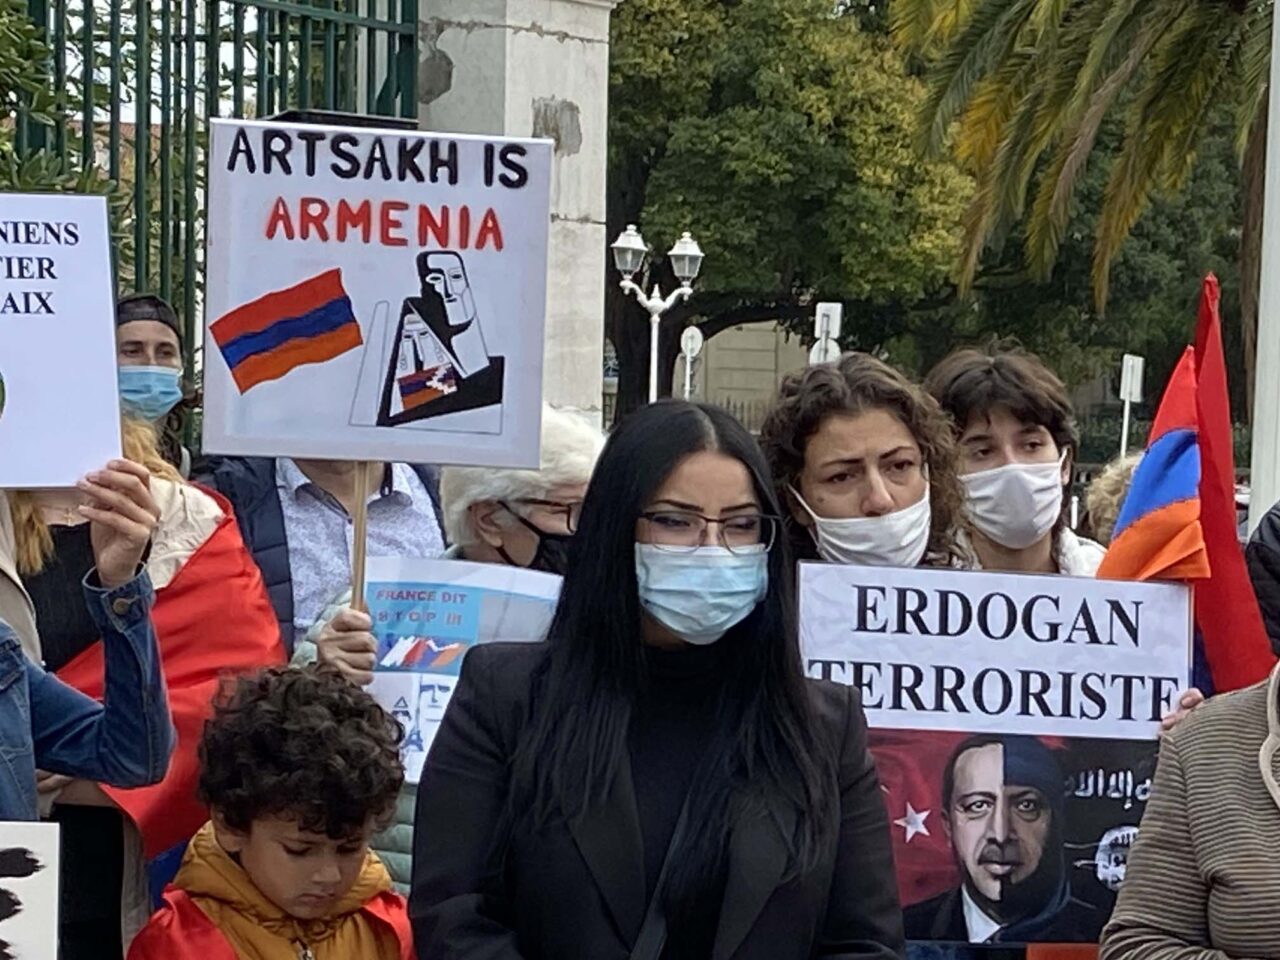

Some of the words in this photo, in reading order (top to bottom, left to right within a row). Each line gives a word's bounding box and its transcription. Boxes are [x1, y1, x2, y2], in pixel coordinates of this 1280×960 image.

[227, 127, 459, 187] ARTSAKH
[483, 142, 529, 189] IS
[265, 196, 504, 251] ARMENIA
[376, 589, 436, 602] FRANCE
[441, 591, 468, 604] DIT
[378, 610, 437, 623] STOP
[852, 584, 1144, 648] ERDOGAN
[808, 658, 1178, 722] TERRORISTE
